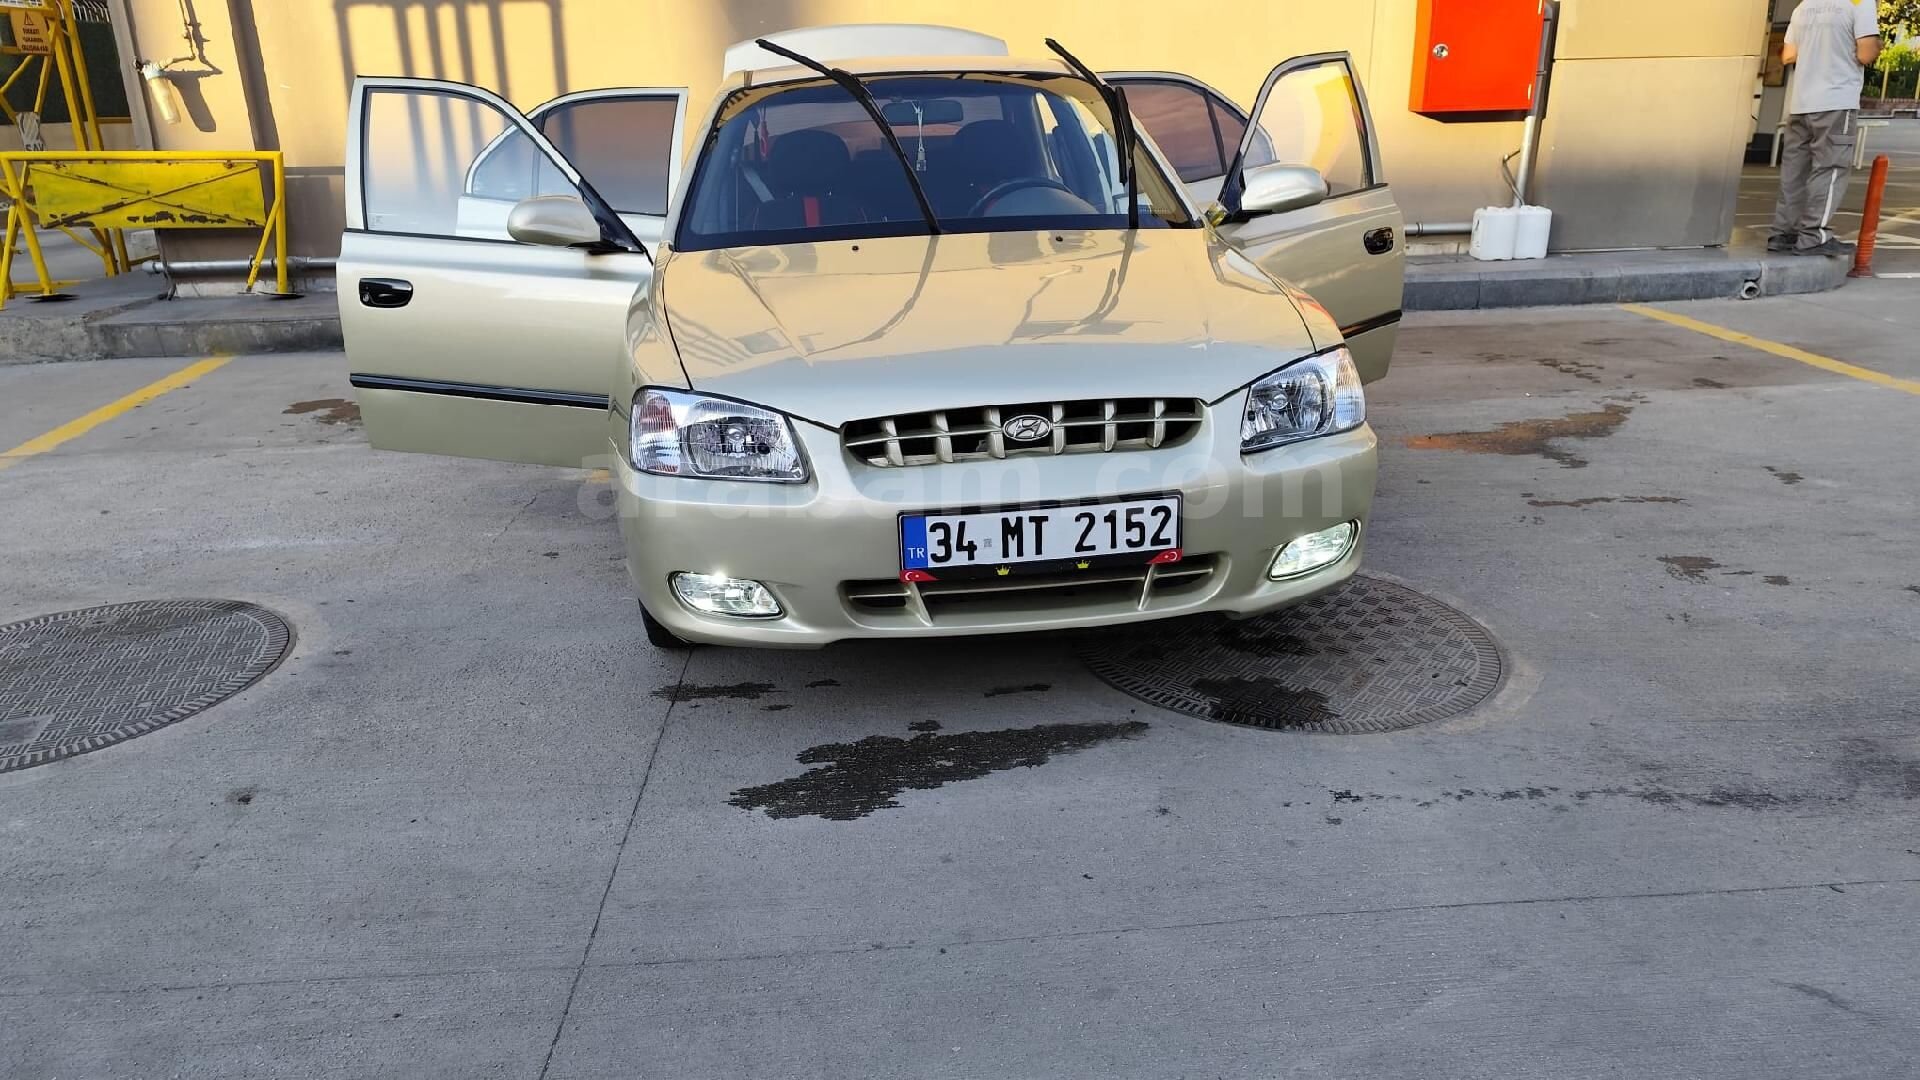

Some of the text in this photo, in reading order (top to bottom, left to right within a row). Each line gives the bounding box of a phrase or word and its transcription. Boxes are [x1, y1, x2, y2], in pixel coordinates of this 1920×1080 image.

[929, 505, 1172, 563] 34 MT 2152
[908, 547, 925, 559] TR
